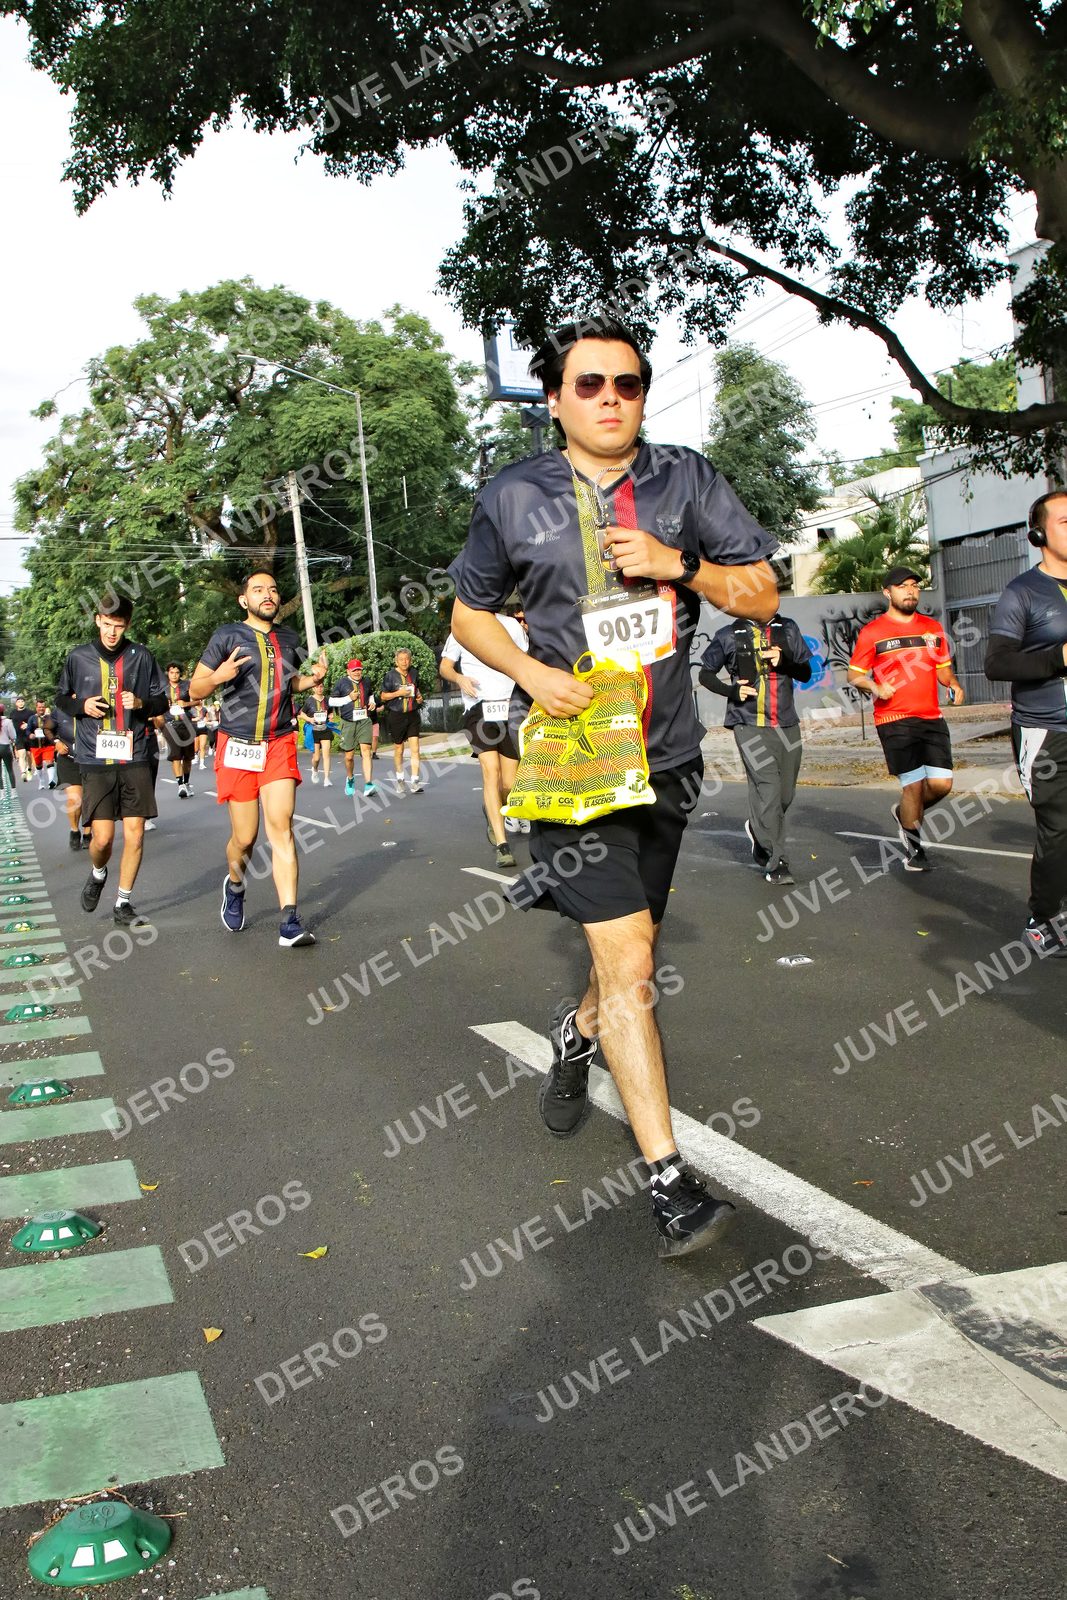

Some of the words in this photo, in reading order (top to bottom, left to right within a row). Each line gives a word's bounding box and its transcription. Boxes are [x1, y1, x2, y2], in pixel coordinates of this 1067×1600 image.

[598, 608, 659, 647] 9037
[486, 704, 507, 714] 8510
[102, 738, 126, 749] 8449
[228, 746, 262, 760] 13498
[590, 796, 616, 807] ASCENSO
